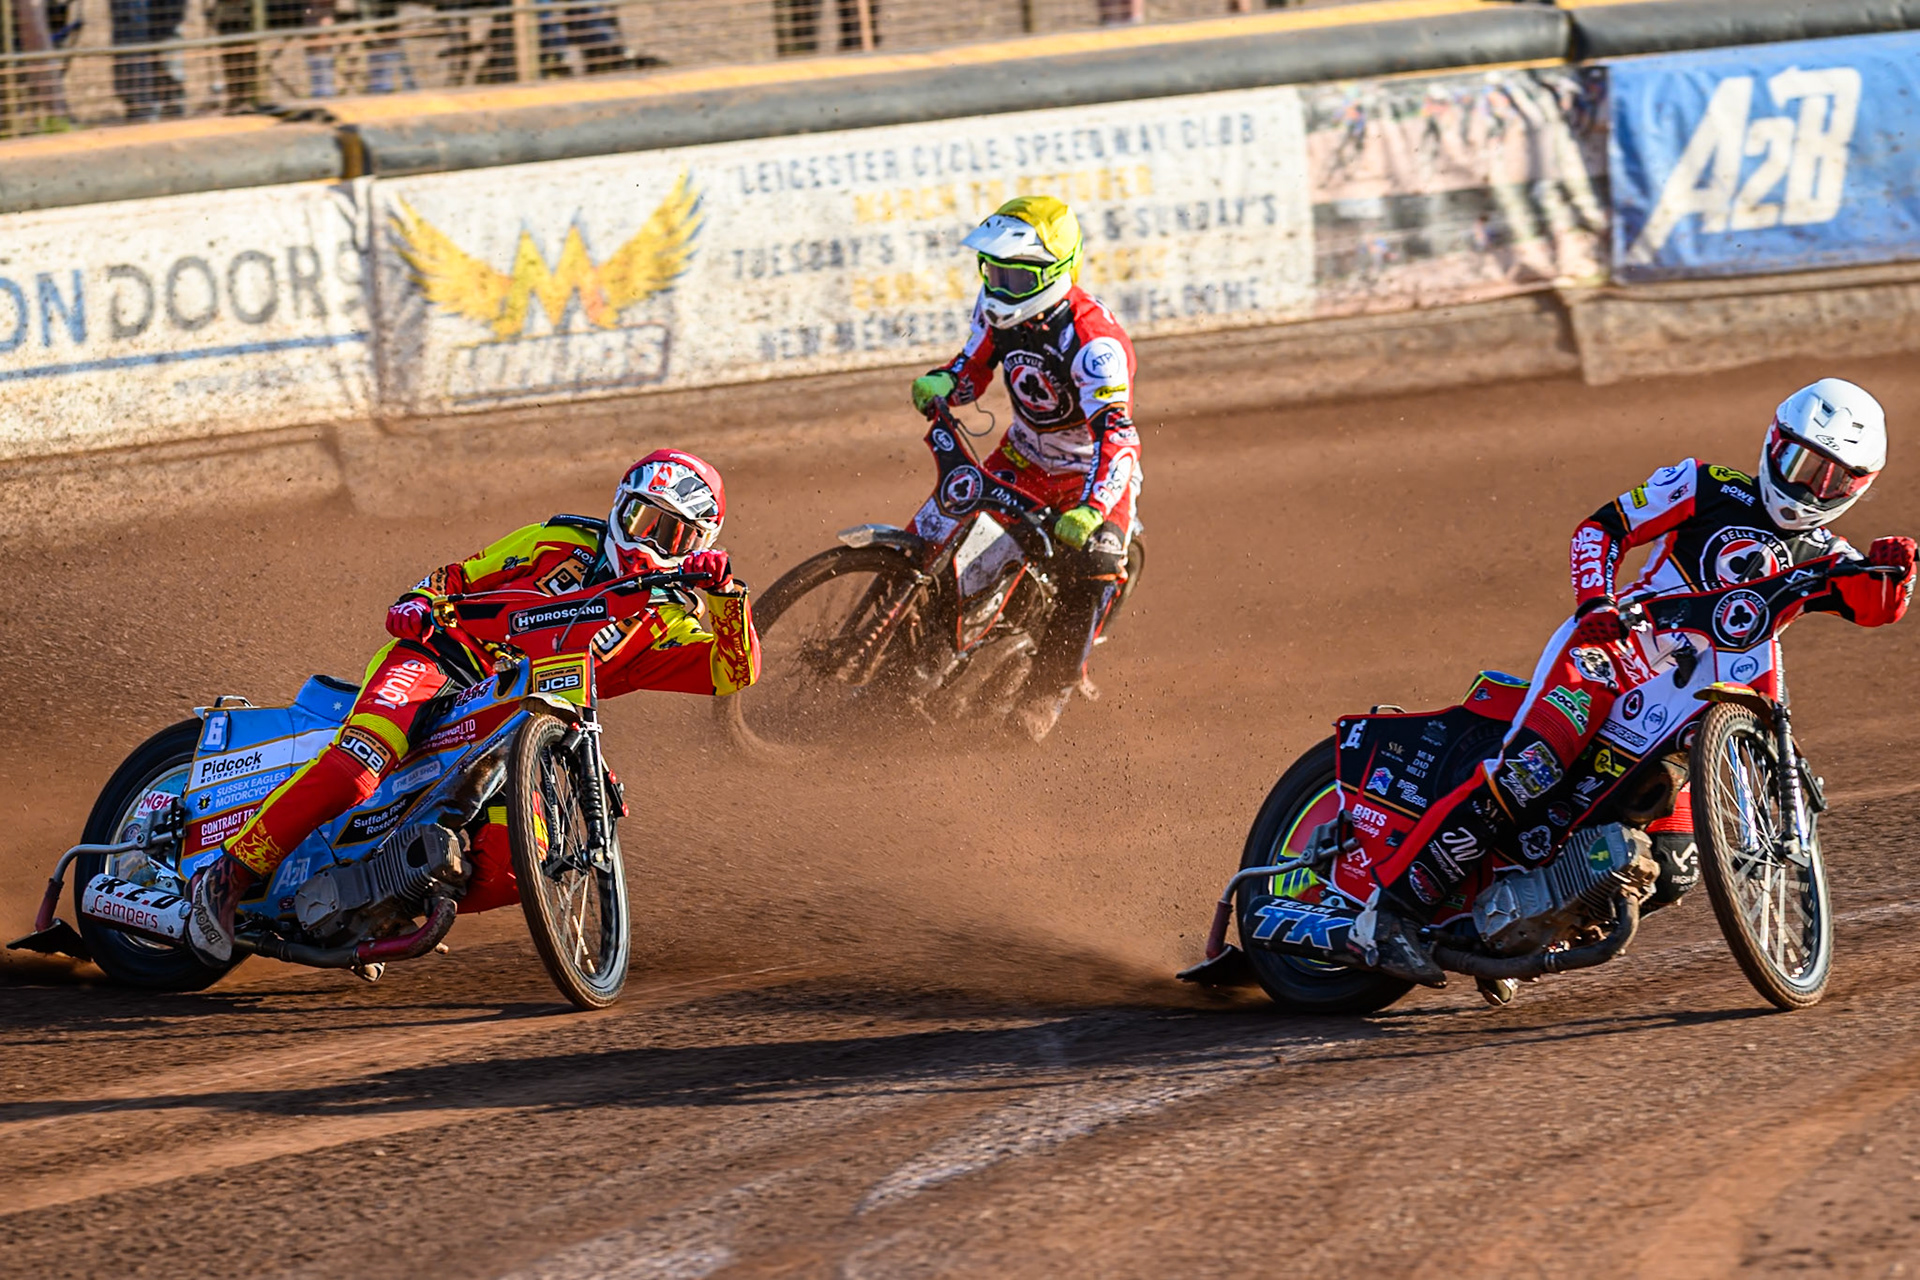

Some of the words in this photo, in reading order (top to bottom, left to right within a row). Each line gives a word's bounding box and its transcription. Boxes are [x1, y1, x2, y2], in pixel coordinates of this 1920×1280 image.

[740, 149, 899, 194] LEICESTER
[913, 139, 1002, 176] CYCLE
[1181, 114, 1254, 149] CLUB
[1624, 65, 1862, 265] A2B
[1720, 484, 1756, 504] ROWE
[1720, 530, 1755, 543] BELLE
[1760, 535, 1783, 553] VUE
[1579, 527, 1604, 588] BRTS
[517, 604, 604, 627] HYDROSCAND
[539, 673, 579, 692] JCB
[1549, 691, 1578, 714] ROCK
[208, 716, 225, 746] 6
[460, 719, 475, 733] LTD
[1346, 723, 1363, 747] 6
[201, 751, 263, 777] Pidcock
[341, 738, 383, 772] JCB
[1412, 759, 1429, 769] DAD
[200, 765, 261, 784] MOTORCYCLES
[216, 779, 250, 797] SUSSEX
[251, 771, 286, 791] EAGLES
[201, 813, 243, 836] CONTRACT
[353, 810, 388, 828] Suffolk
[387, 798, 407, 819] Floor
[1352, 804, 1387, 827] BRTS
[273, 857, 311, 894] A2B
[94, 894, 158, 929] Campers
[1270, 898, 1338, 914] TEAM
[1252, 905, 1356, 950] TK
